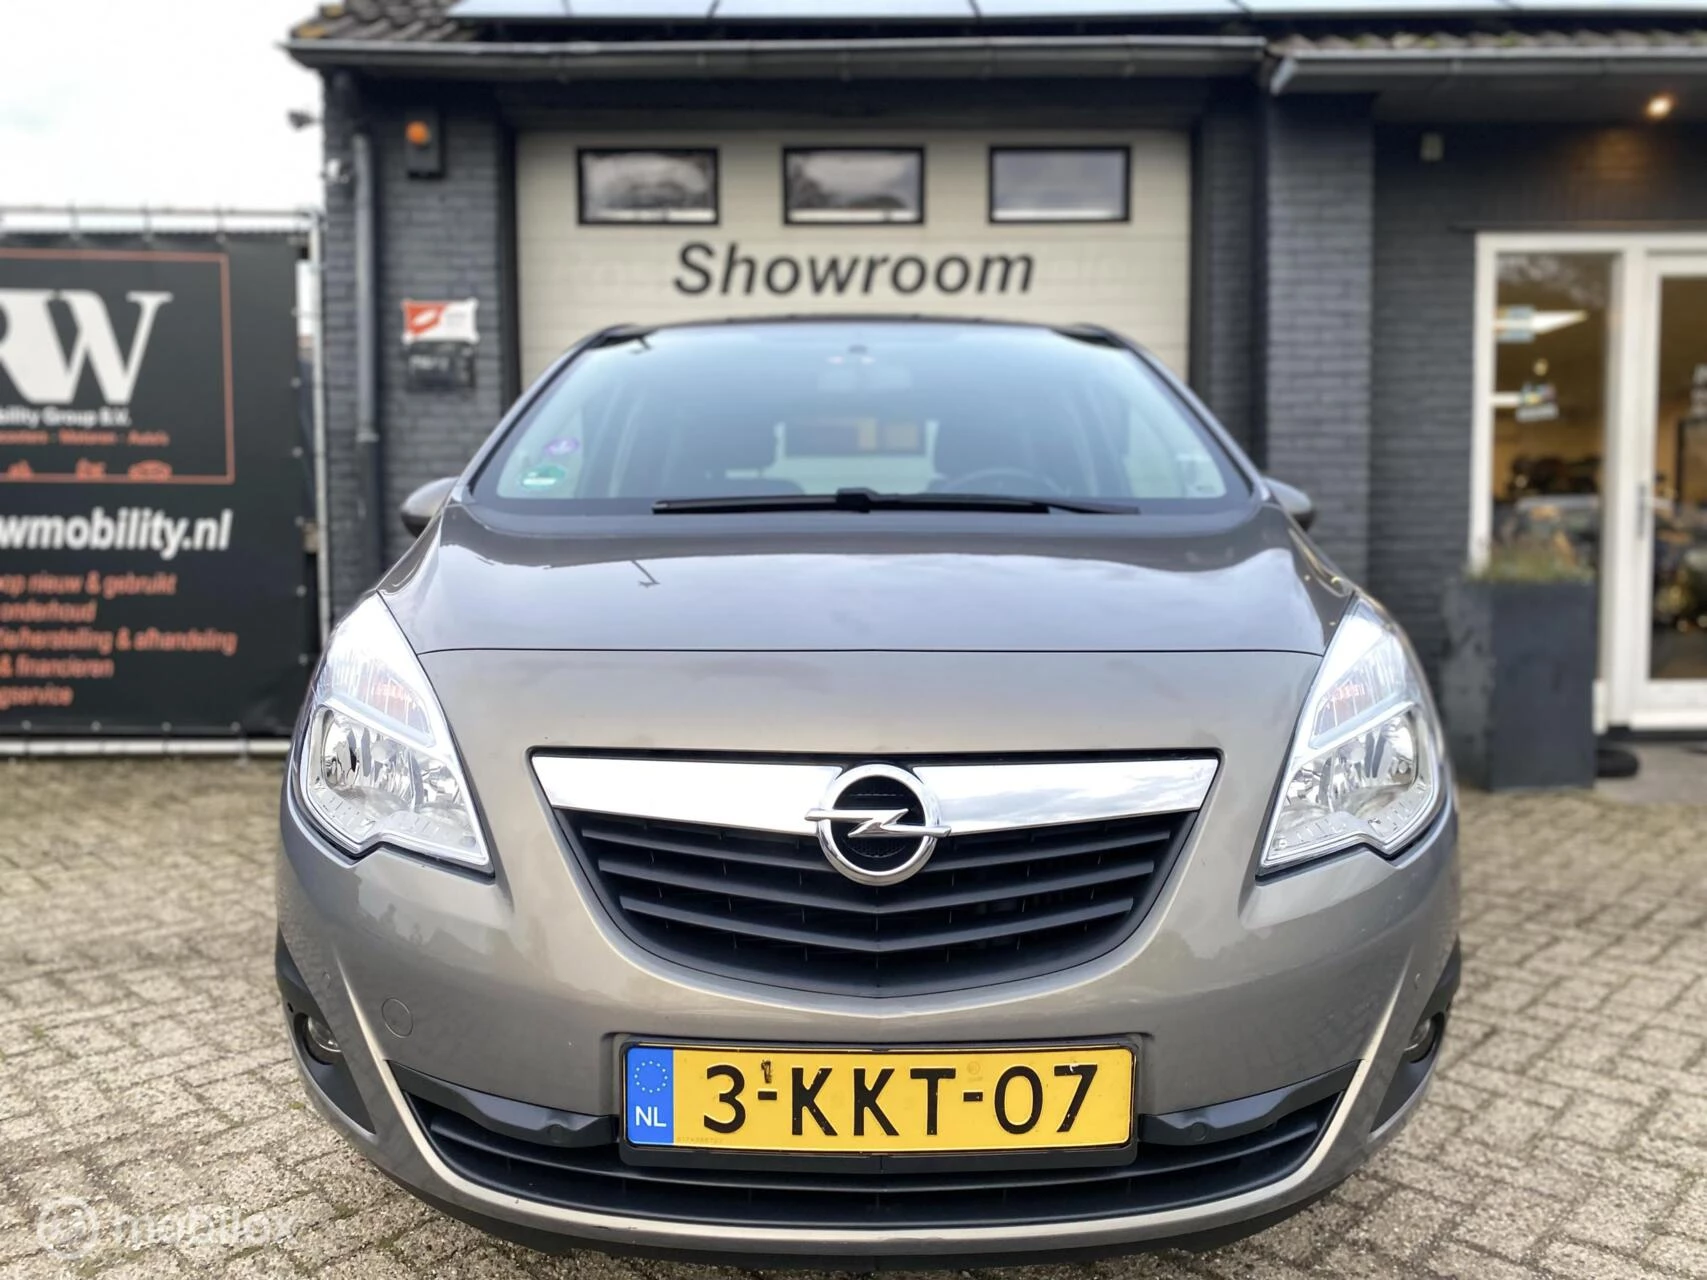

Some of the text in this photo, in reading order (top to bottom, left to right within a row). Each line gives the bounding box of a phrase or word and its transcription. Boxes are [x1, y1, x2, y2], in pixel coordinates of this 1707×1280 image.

[673, 241, 1035, 296] Showroom
[85, 570, 101, 595] &
[115, 626, 131, 651] &
[703, 1063, 1098, 1137] 3-KKT-07
[635, 1105, 667, 1128] NL
